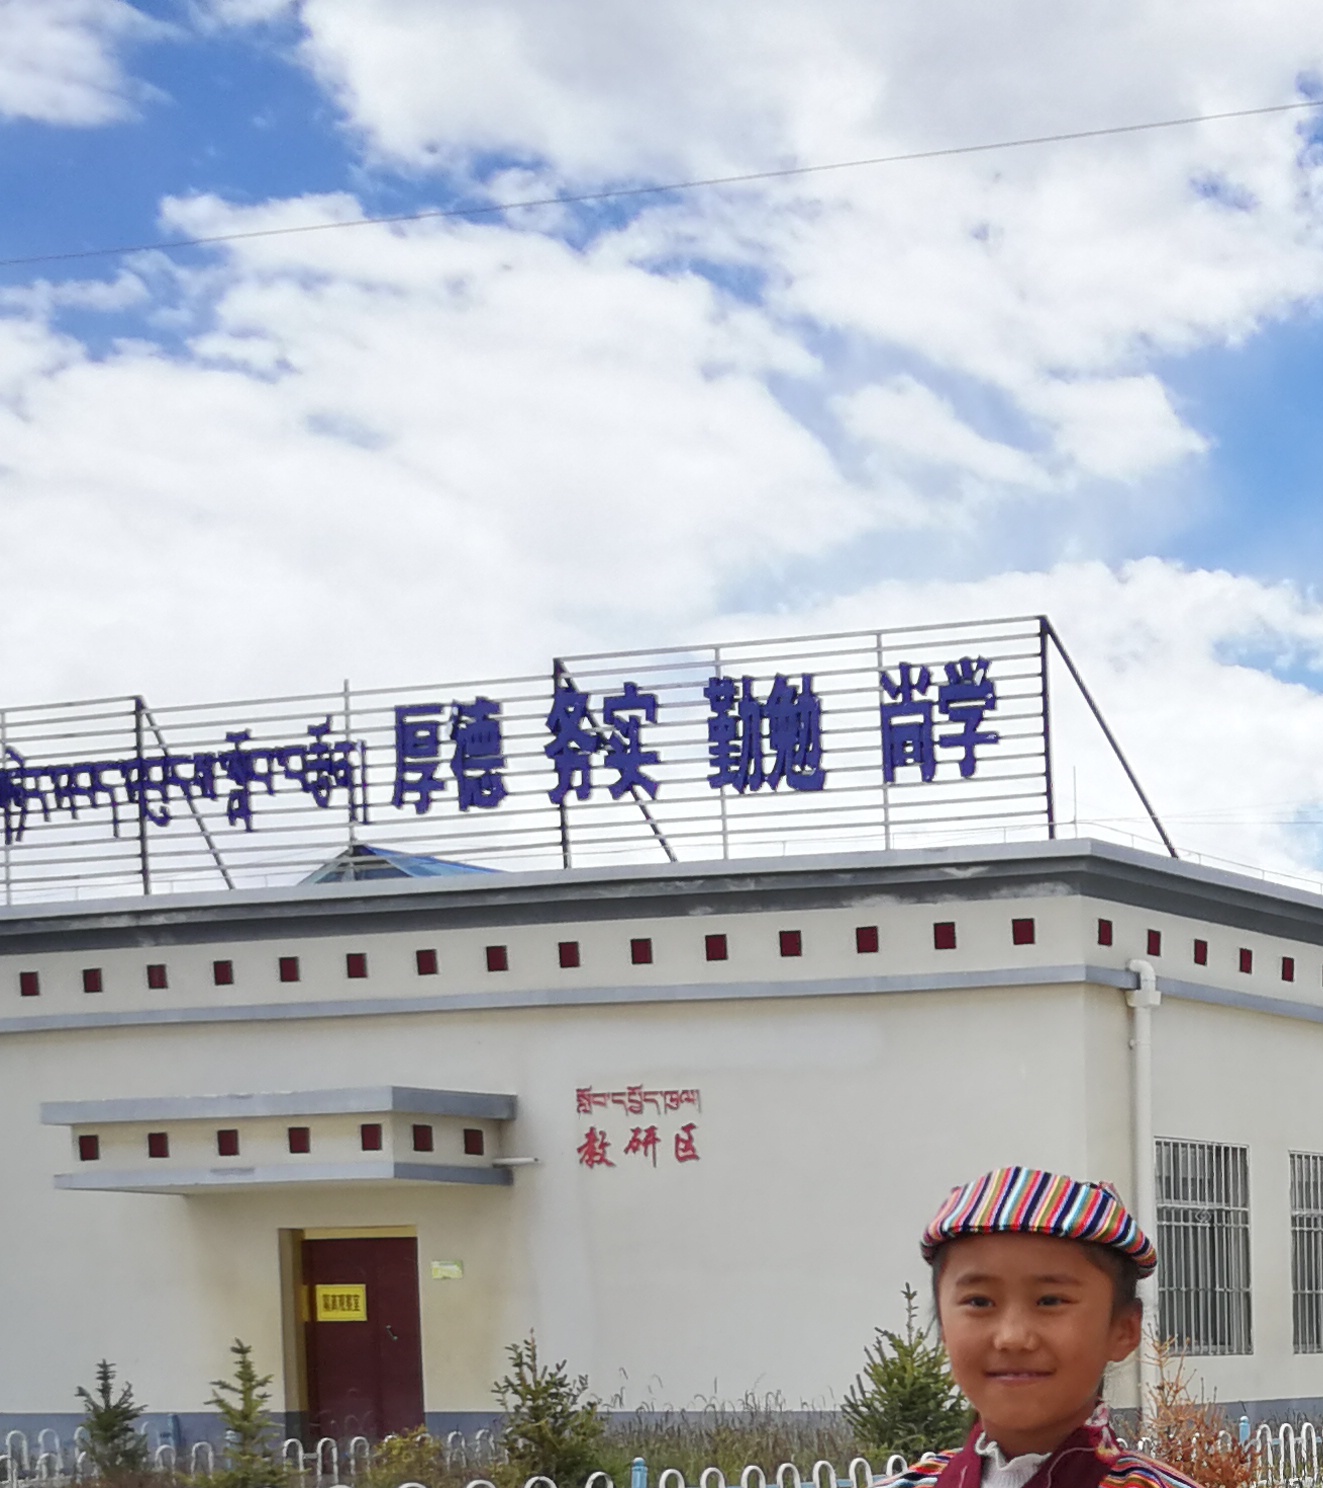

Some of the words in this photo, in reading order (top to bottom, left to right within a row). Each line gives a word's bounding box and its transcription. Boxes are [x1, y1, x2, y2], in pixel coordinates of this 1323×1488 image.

[391, 696, 510, 814] 厚德
[544, 681, 662, 805] 务实
[703, 672, 826, 794] 勤勉
[880, 655, 1000, 787] 尚学
[576, 1122, 702, 1169] 教研区
